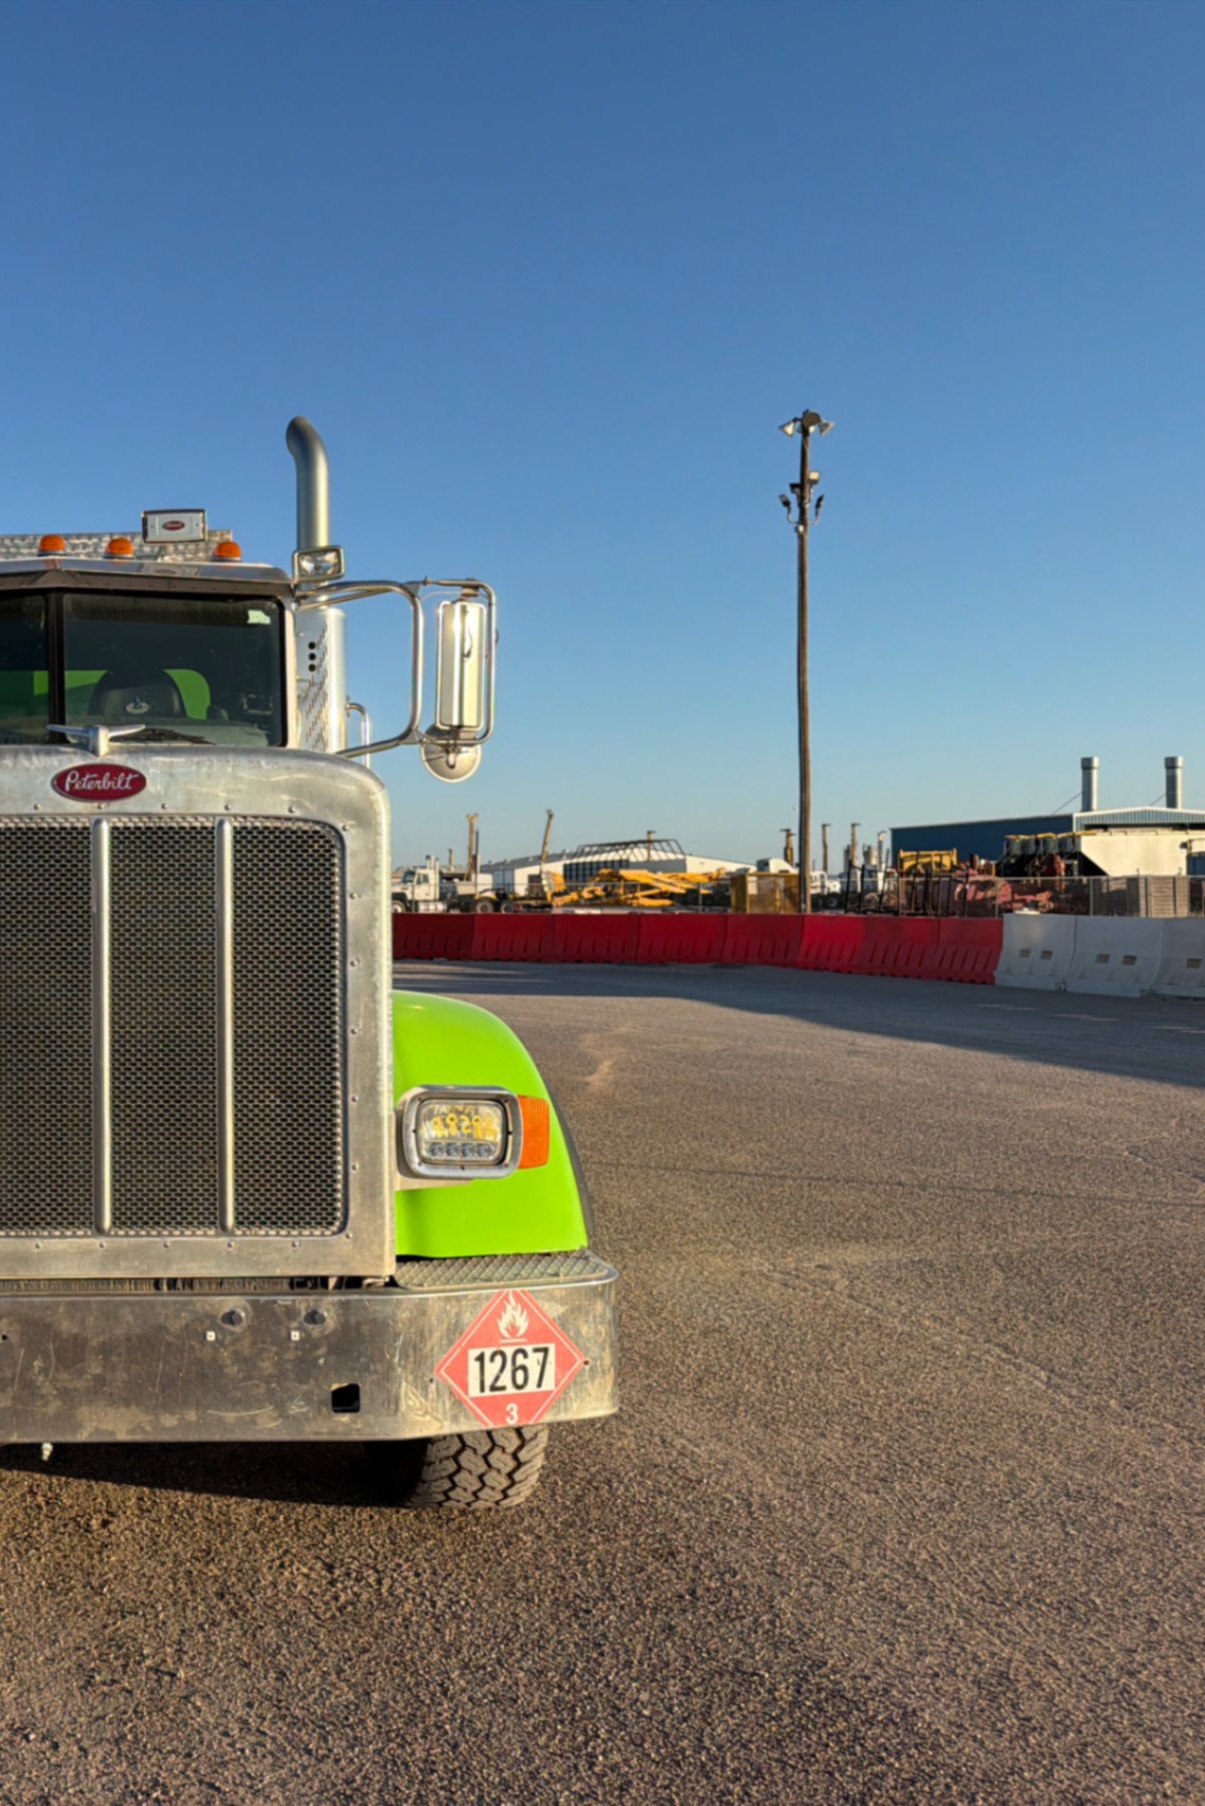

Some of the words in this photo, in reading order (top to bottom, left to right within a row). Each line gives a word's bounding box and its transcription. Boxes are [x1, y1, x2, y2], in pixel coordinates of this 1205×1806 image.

[64, 769, 139, 792] Peterbilt
[474, 1346, 549, 1393] 1267
[506, 1403, 519, 1425] 3
